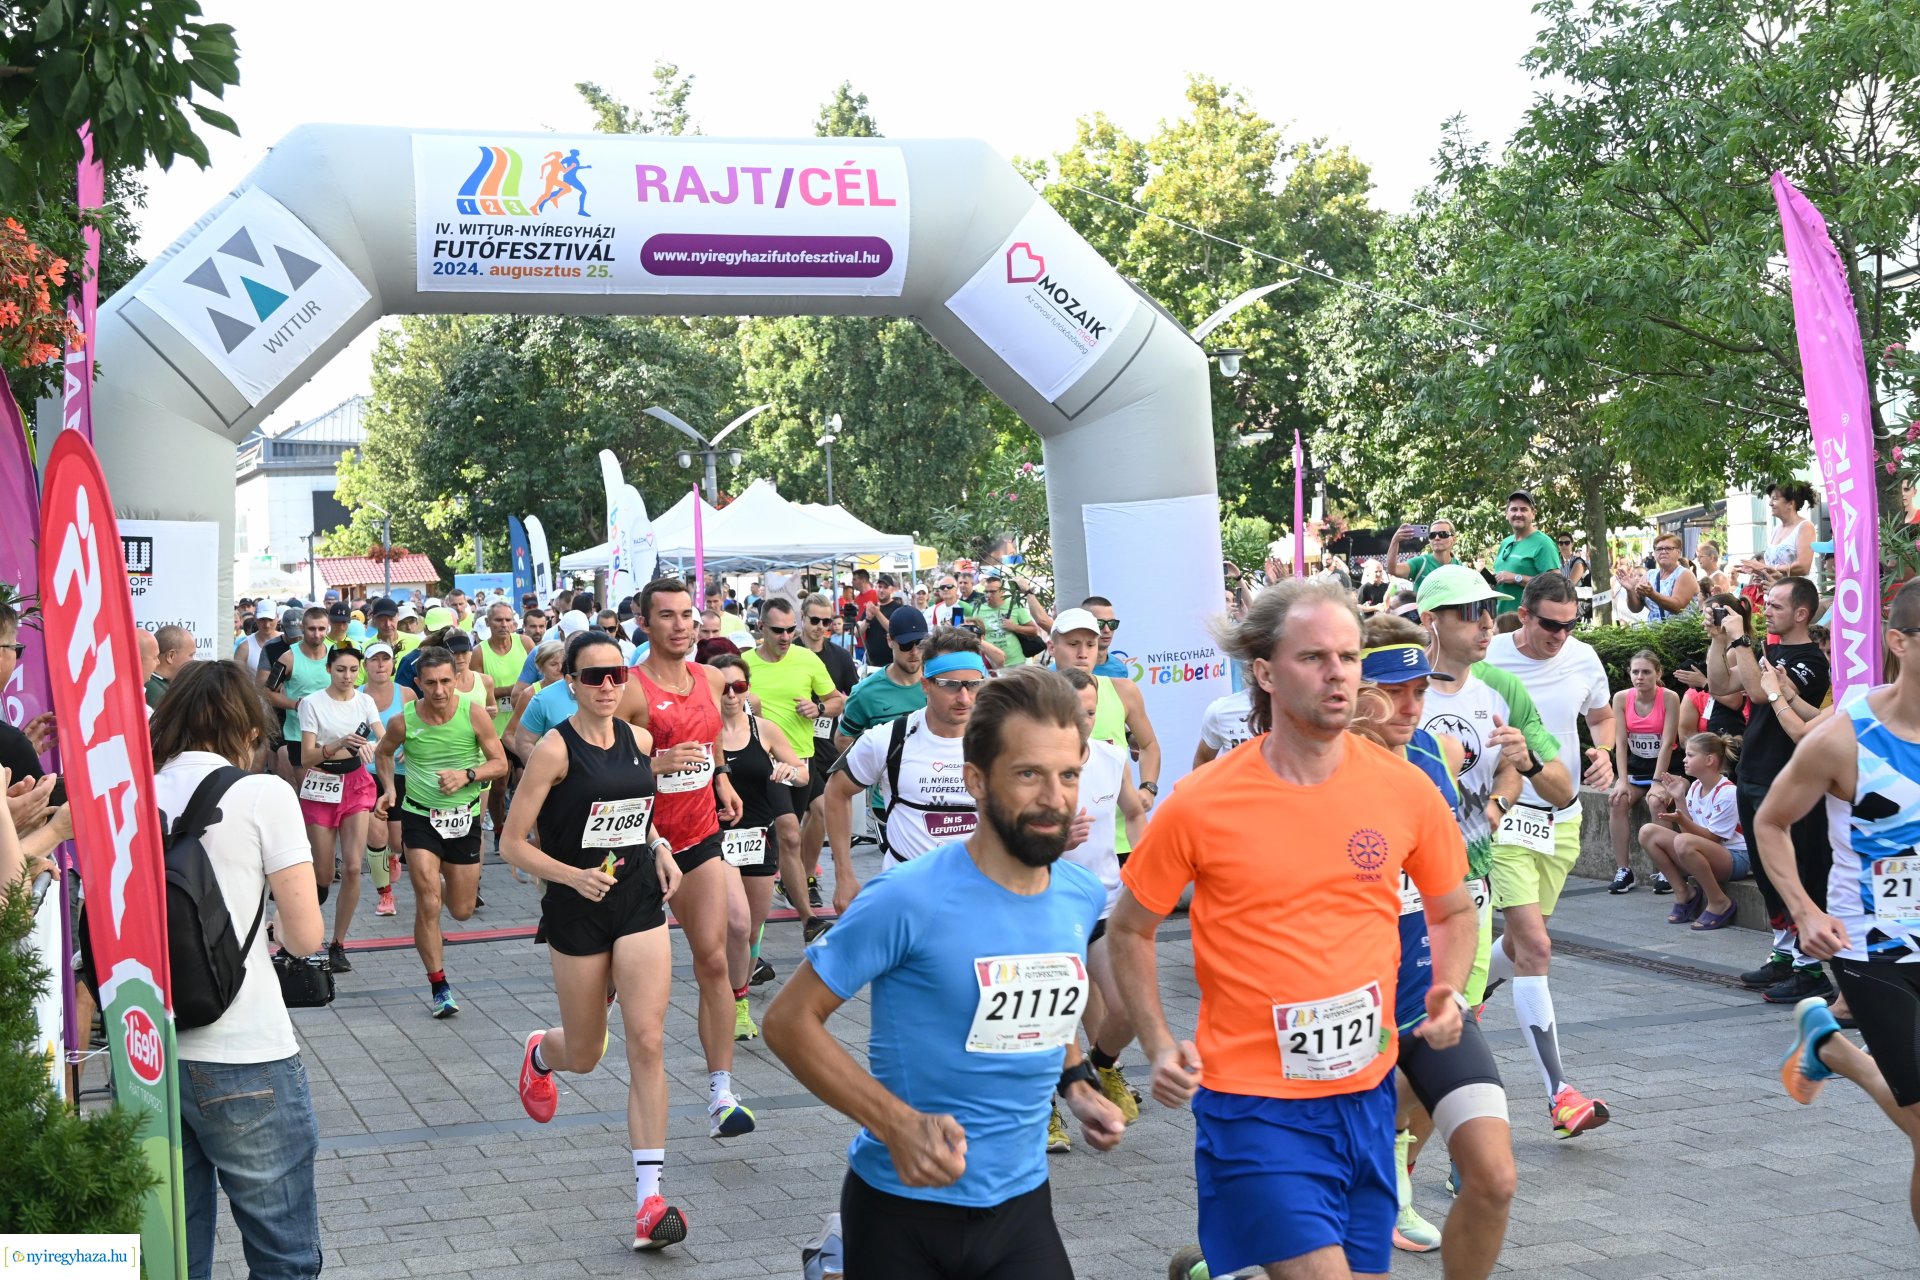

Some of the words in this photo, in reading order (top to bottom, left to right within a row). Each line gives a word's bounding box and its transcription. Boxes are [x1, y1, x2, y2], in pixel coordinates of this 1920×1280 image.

[635, 160, 896, 208] RAJT/CÉL
[435, 223, 454, 235] IV.
[459, 222, 615, 239] WITTUR-NYÍREGYHÁZI
[433, 236, 615, 261] FUTÓFESZTIVÁL
[653, 248, 880, 266] www.nyiregyhazifutofesztival.hu
[433, 262, 484, 276] 2024.
[489, 265, 581, 280] augusztus
[586, 264, 613, 278] 25.
[1038, 275, 1106, 340] MOZAIK
[263, 300, 322, 354] WITTUR
[1076, 328, 1098, 347] med
[129, 577, 153, 586] OPE
[1147, 647, 1215, 663] NYÍREGYHÁZA
[1149, 663, 1209, 685] Többet
[1213, 658, 1227, 677] ad
[815, 719, 830, 728] 163
[1631, 740, 1660, 749] 10018
[304, 779, 340, 793] 21156
[920, 785, 967, 793] FUTÓFESZT
[931, 776, 965, 784] NYÍREGY
[591, 813, 645, 831] 21088
[931, 823, 977, 834] LEFUTOTTAM
[943, 816, 953, 824] ÉN
[1503, 818, 1550, 839] 21025
[727, 839, 762, 854] 21022
[1883, 878, 1920, 897] 21
[985, 987, 1080, 1020] 21112
[1290, 1012, 1375, 1054] 21121
